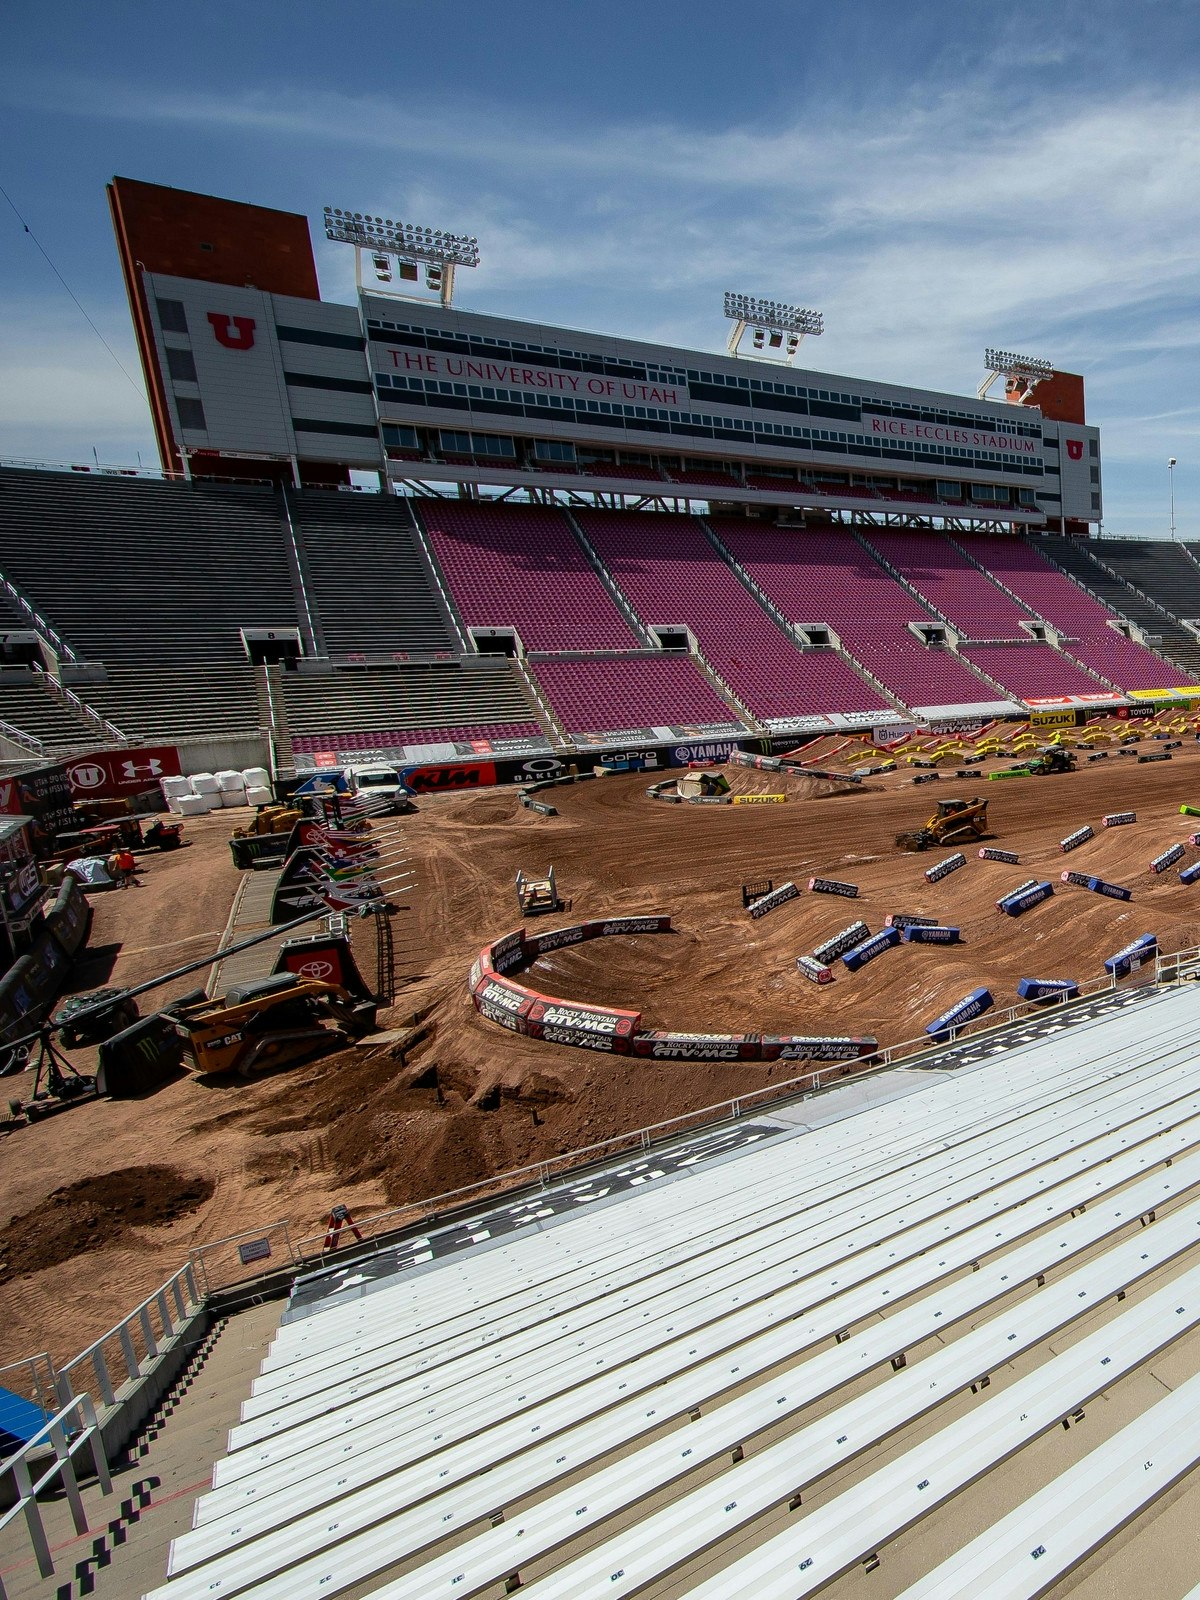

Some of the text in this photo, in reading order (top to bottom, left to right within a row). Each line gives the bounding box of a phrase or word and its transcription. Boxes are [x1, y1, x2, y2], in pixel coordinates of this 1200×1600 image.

[388, 350, 678, 405] THE UNIVERSITY OF UTAH
[872, 418, 1036, 452] RICE-ECCLES STADIUM
[267, 632, 276, 640] 8
[1130, 708, 1154, 716] TOYOTA
[1032, 714, 1075, 726] SUZUKI
[601, 751, 657, 763] GoPro
[690, 743, 738, 759] YAMAHA
[341, 756, 386, 764] TOYOTA
[411, 768, 481, 787] KTM
[928, 930, 952, 938] YAMAHA
[867, 938, 891, 957] YAMAHA
[557, 1007, 619, 1024] ROCKY MOUNTAIN
[954, 1002, 981, 1025] YAMAHA
[223, 1031, 243, 1046] CAT
[666, 1041, 739, 1050] ROCKY MOUNTAIN
[794, 1044, 819, 1052] ROCKY
